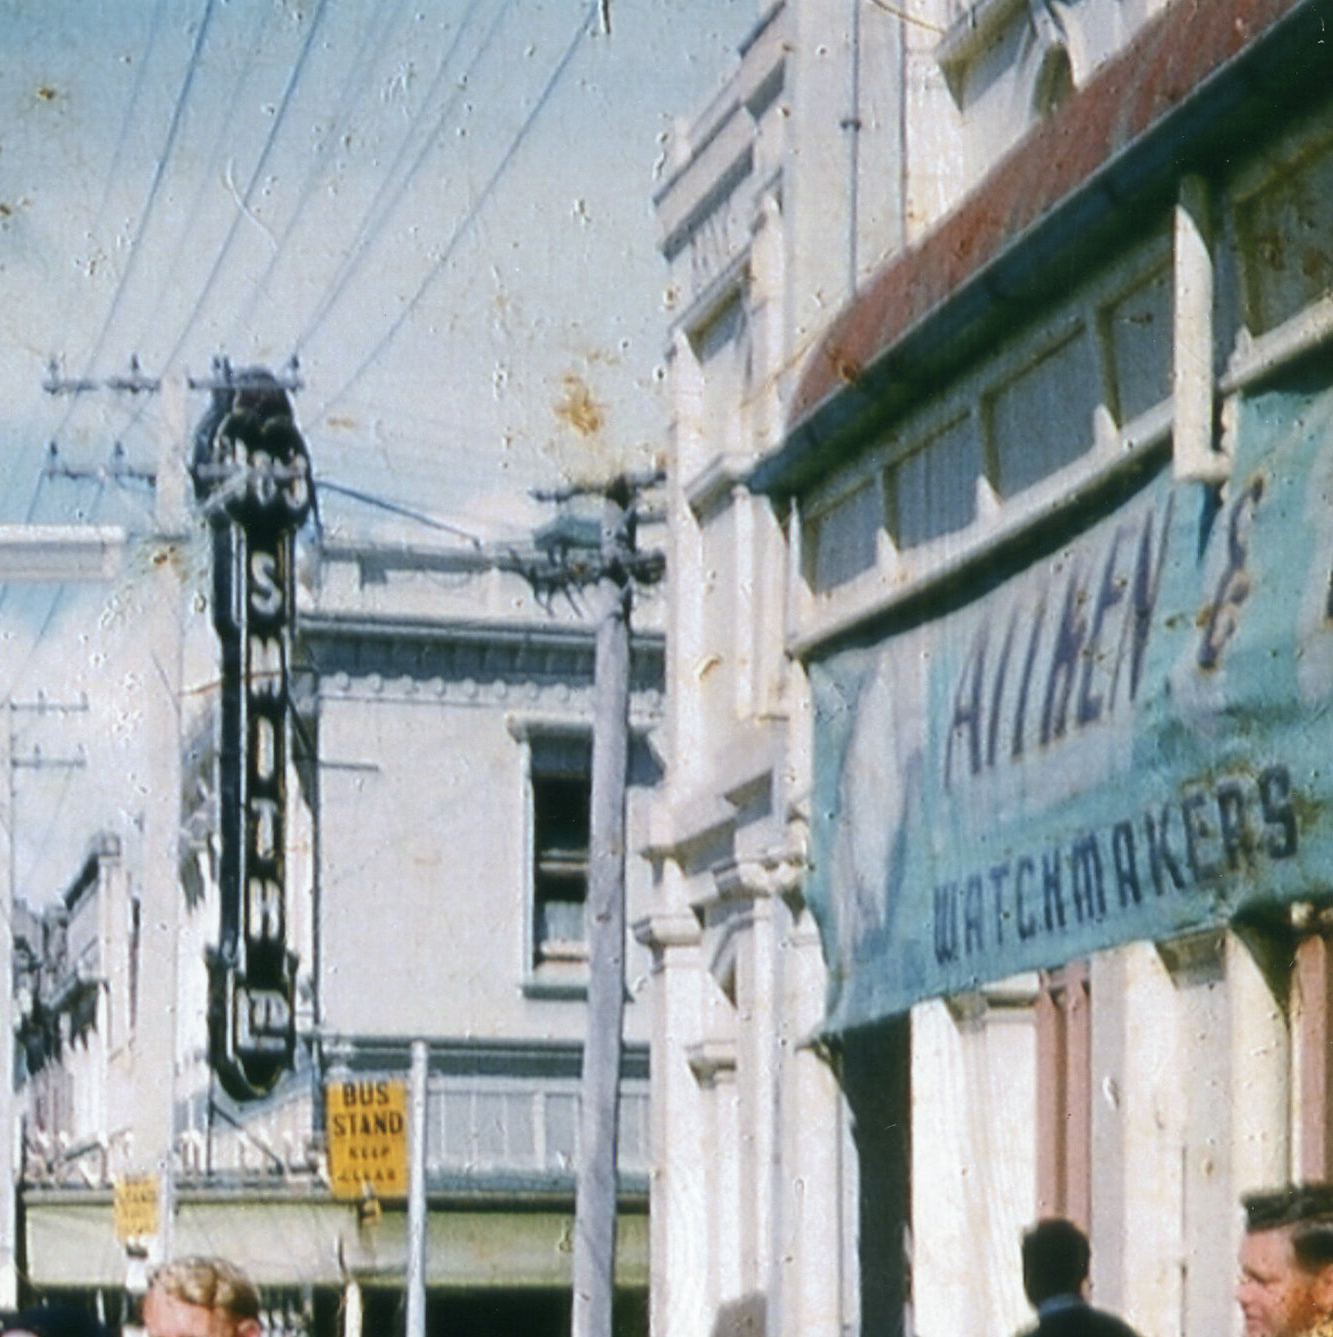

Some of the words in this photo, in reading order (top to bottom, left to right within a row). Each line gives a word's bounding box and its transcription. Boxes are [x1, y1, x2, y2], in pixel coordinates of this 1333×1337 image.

[943, 489, 1176, 795] AITKEN
[250, 550, 283, 940] SMITH
[934, 764, 1297, 962] WATCHMAKERS
[333, 1112, 403, 1135] STAND
[343, 1081, 389, 1106] BUS
